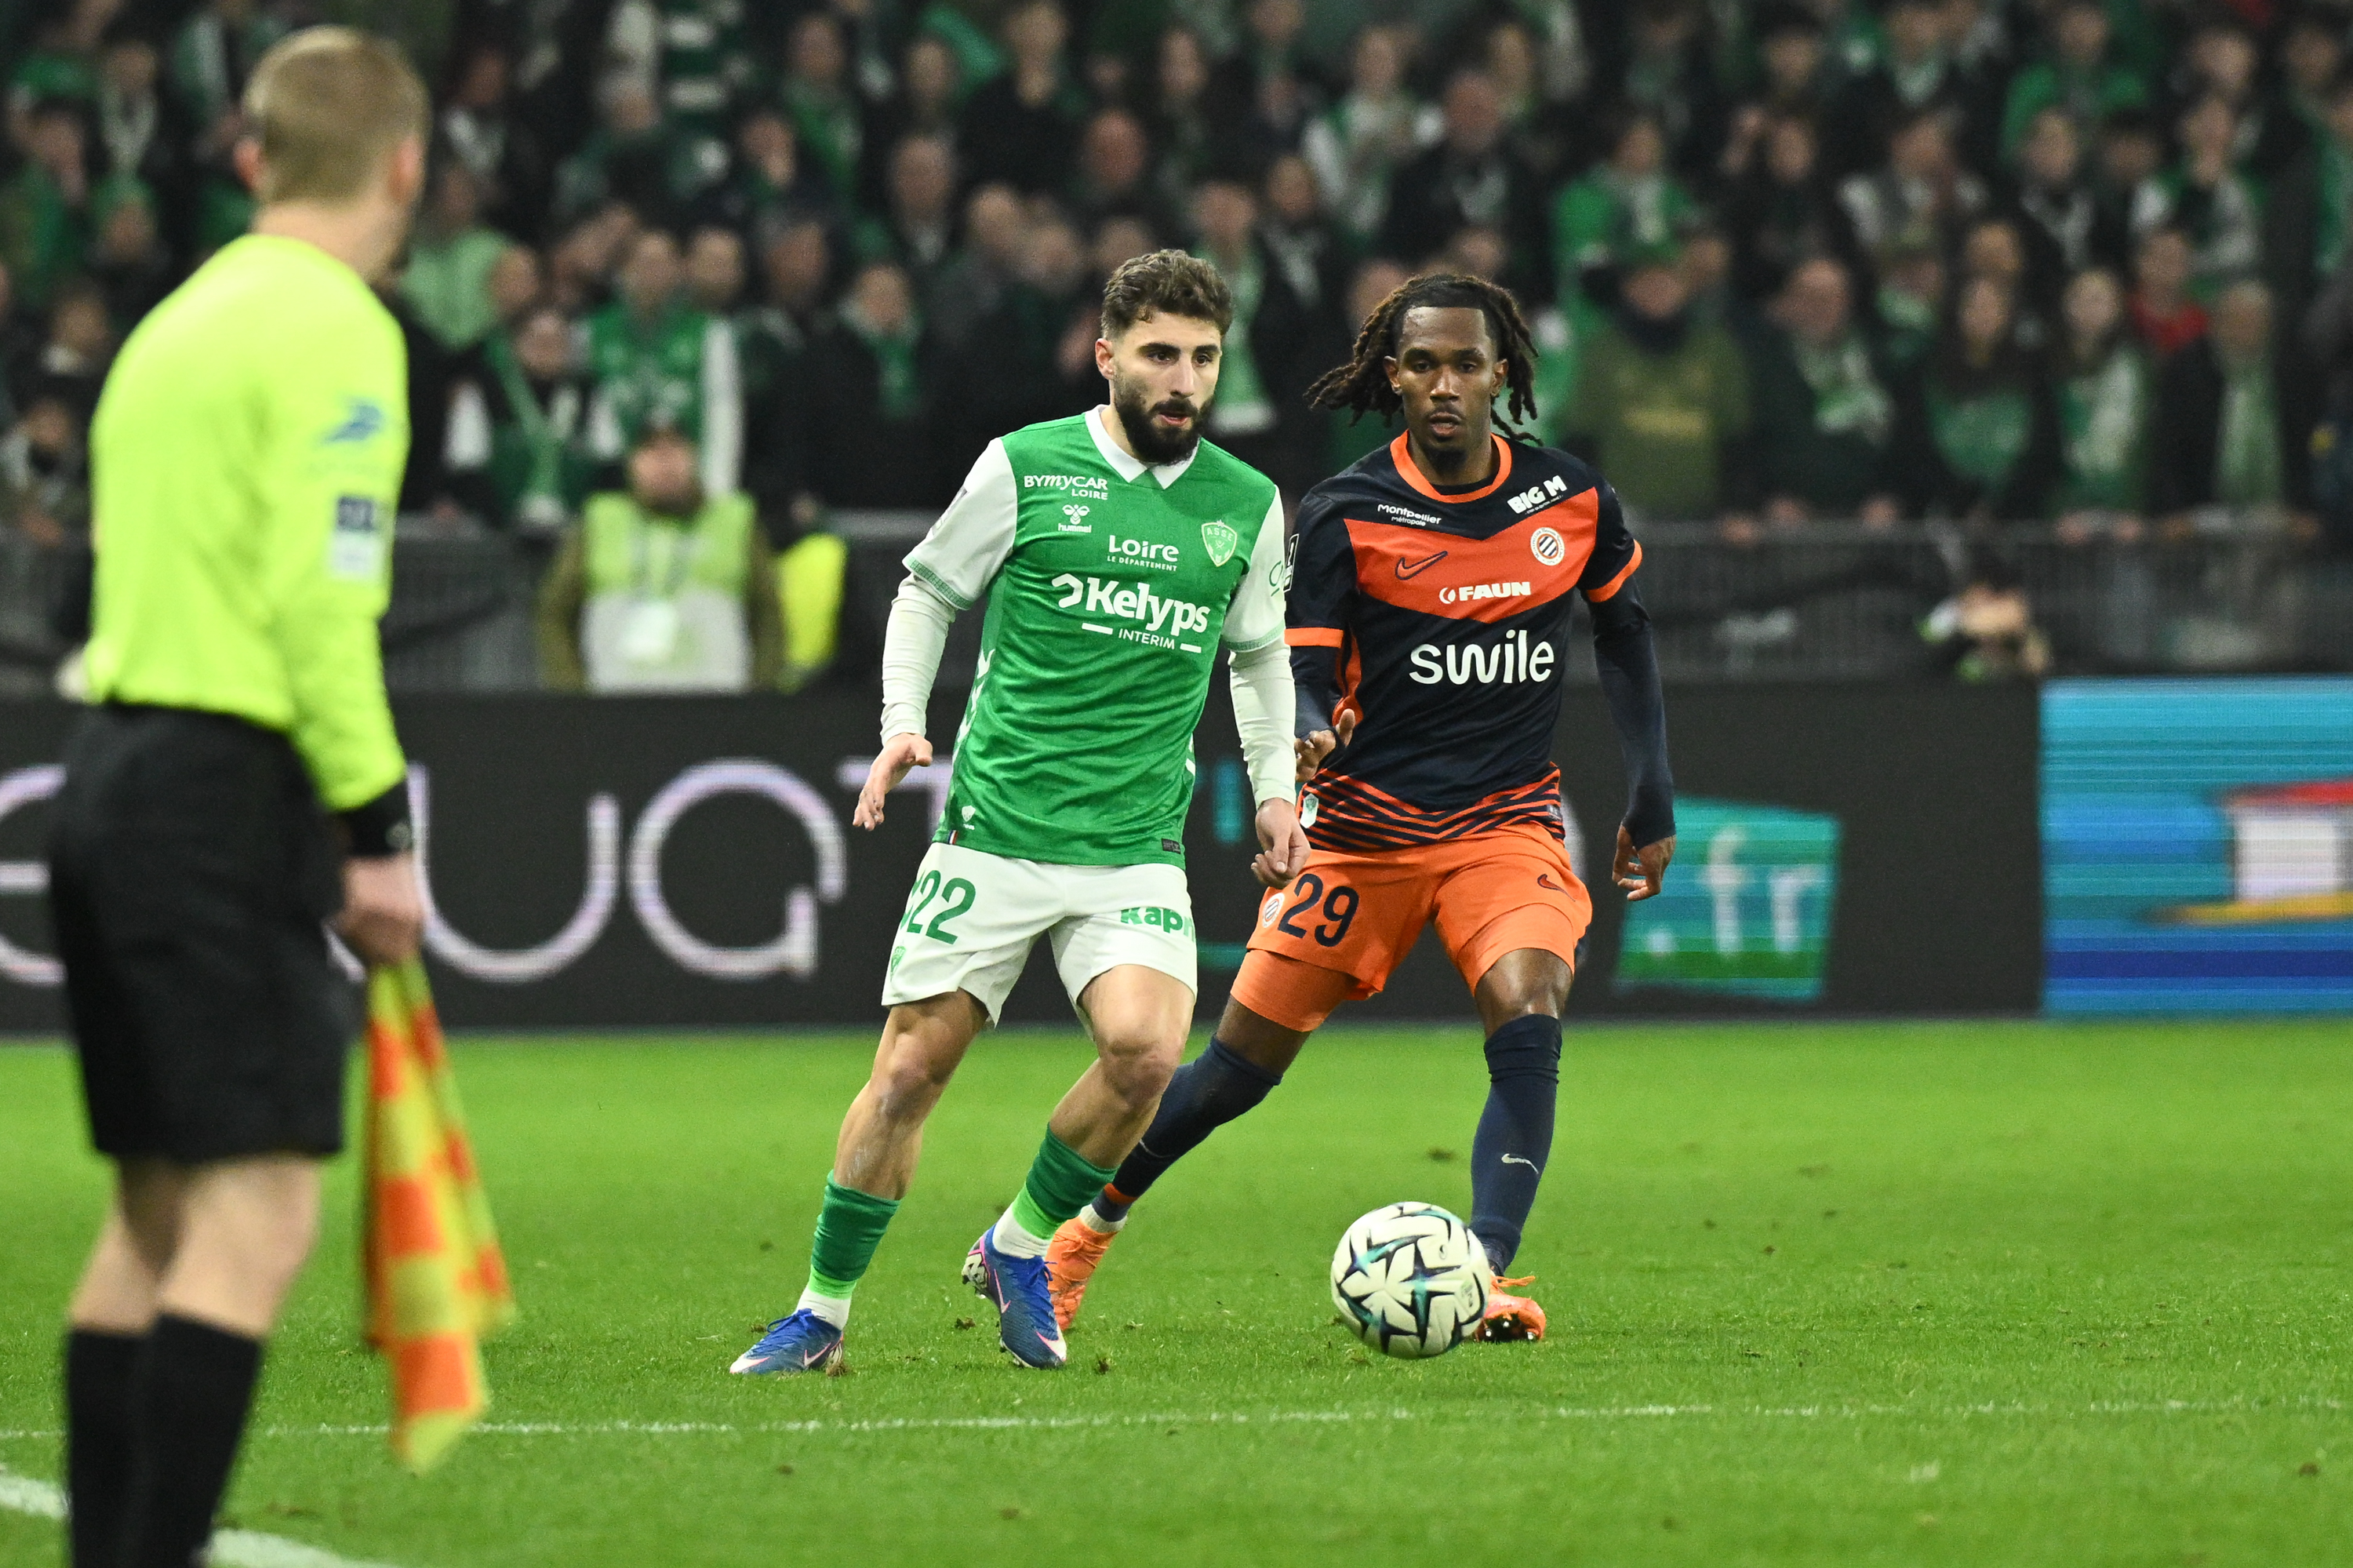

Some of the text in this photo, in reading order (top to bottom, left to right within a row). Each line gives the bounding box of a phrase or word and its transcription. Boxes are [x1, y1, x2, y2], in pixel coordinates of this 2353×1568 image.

[1071, 488, 1108, 500] LOIRE
[1507, 486, 1546, 514] BIG
[1543, 475, 1568, 497] M
[1377, 504, 1442, 525] Montpellier
[1057, 523, 1092, 533] hummel
[1206, 527, 1234, 541] ASSE
[1108, 535, 1180, 562] Loire
[1118, 556, 1177, 572] DÉPARTEMENT
[1459, 581, 1532, 602] FAUN
[1086, 577, 1211, 637] Kelyps
[1118, 628, 1175, 650] INTERIM
[1409, 629, 1555, 685] swile
[906, 869, 976, 945] 22
[1278, 873, 1359, 948] 29
